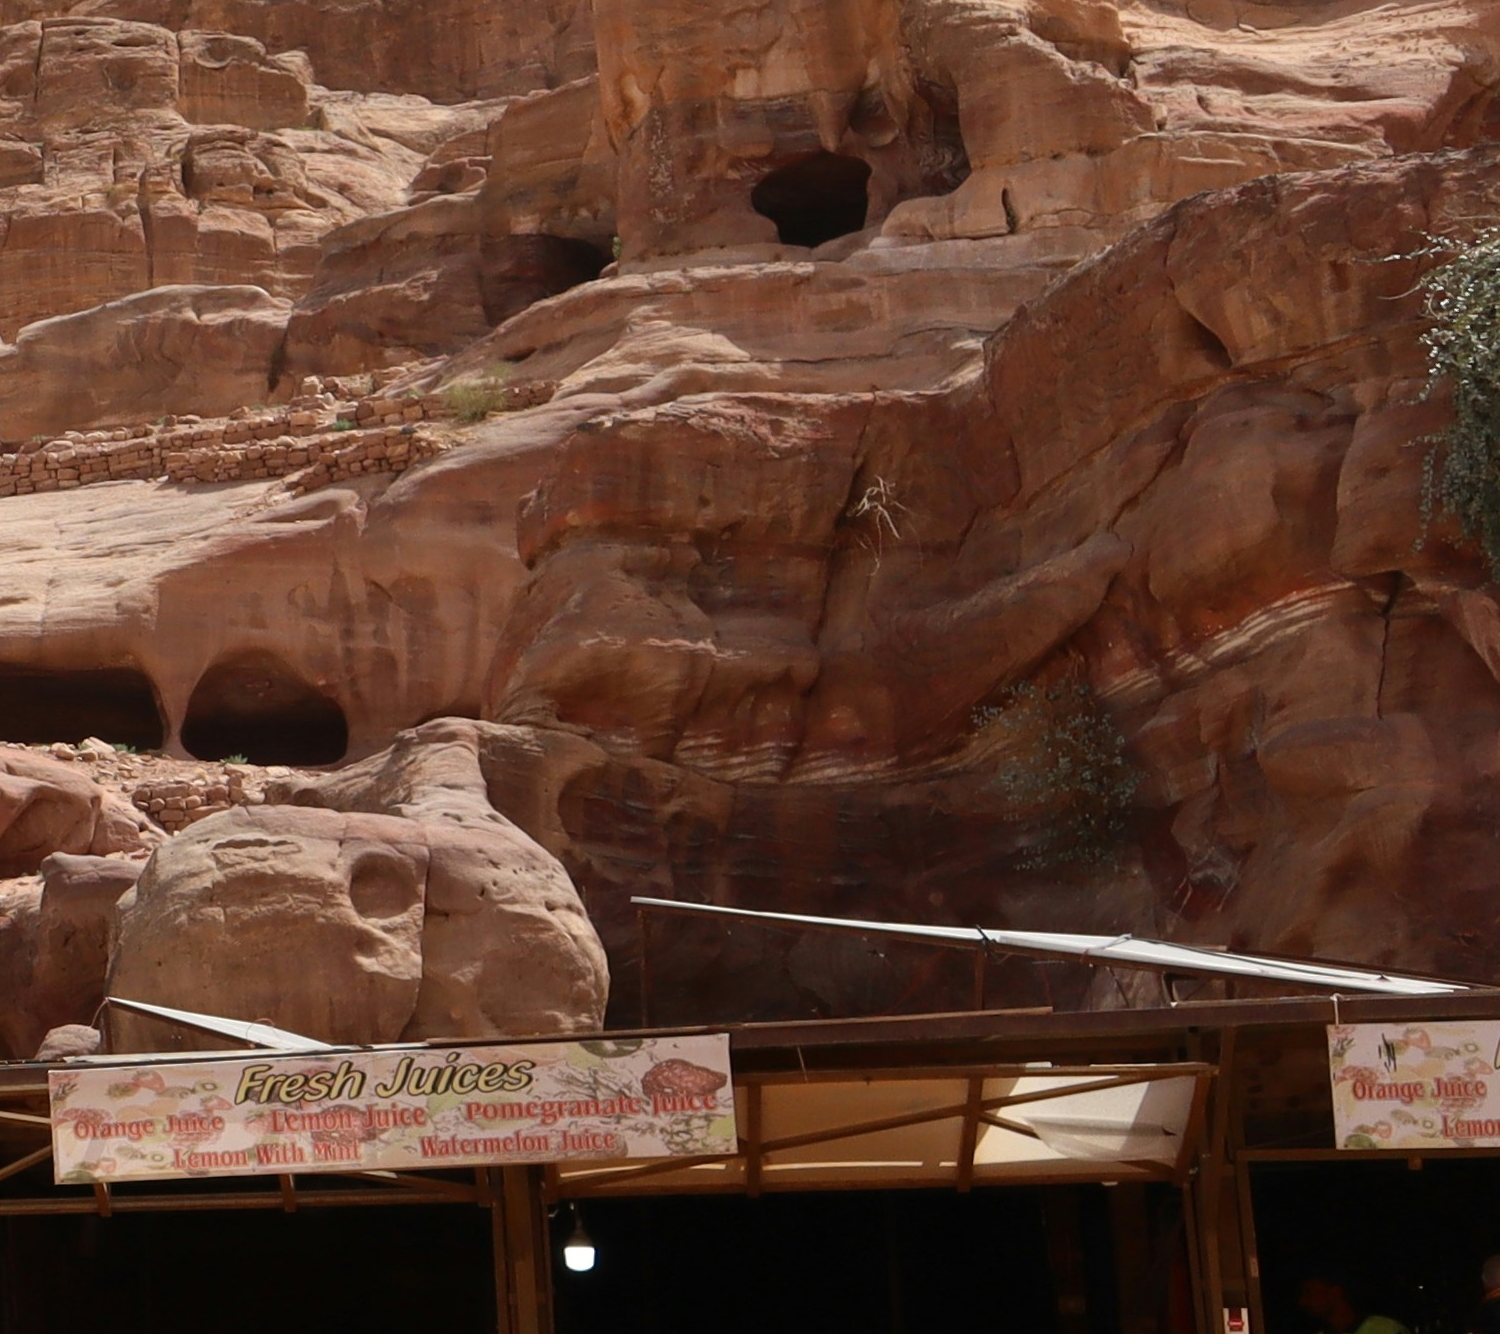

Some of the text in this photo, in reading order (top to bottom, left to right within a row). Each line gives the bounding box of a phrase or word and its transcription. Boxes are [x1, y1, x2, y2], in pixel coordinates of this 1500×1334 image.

[235, 1052, 536, 1105] Fresh Juices
[1352, 1076, 1488, 1104] Orange Juice
[273, 1102, 427, 1133] Lemon Juice
[466, 1089, 717, 1126] Pomegranate Juice
[74, 1113, 225, 1142] Orange Juice
[1442, 1114, 1500, 1139] Lemo
[173, 1140, 362, 1169] Lemon With Mint
[420, 1127, 616, 1158] Watermelon Juice
